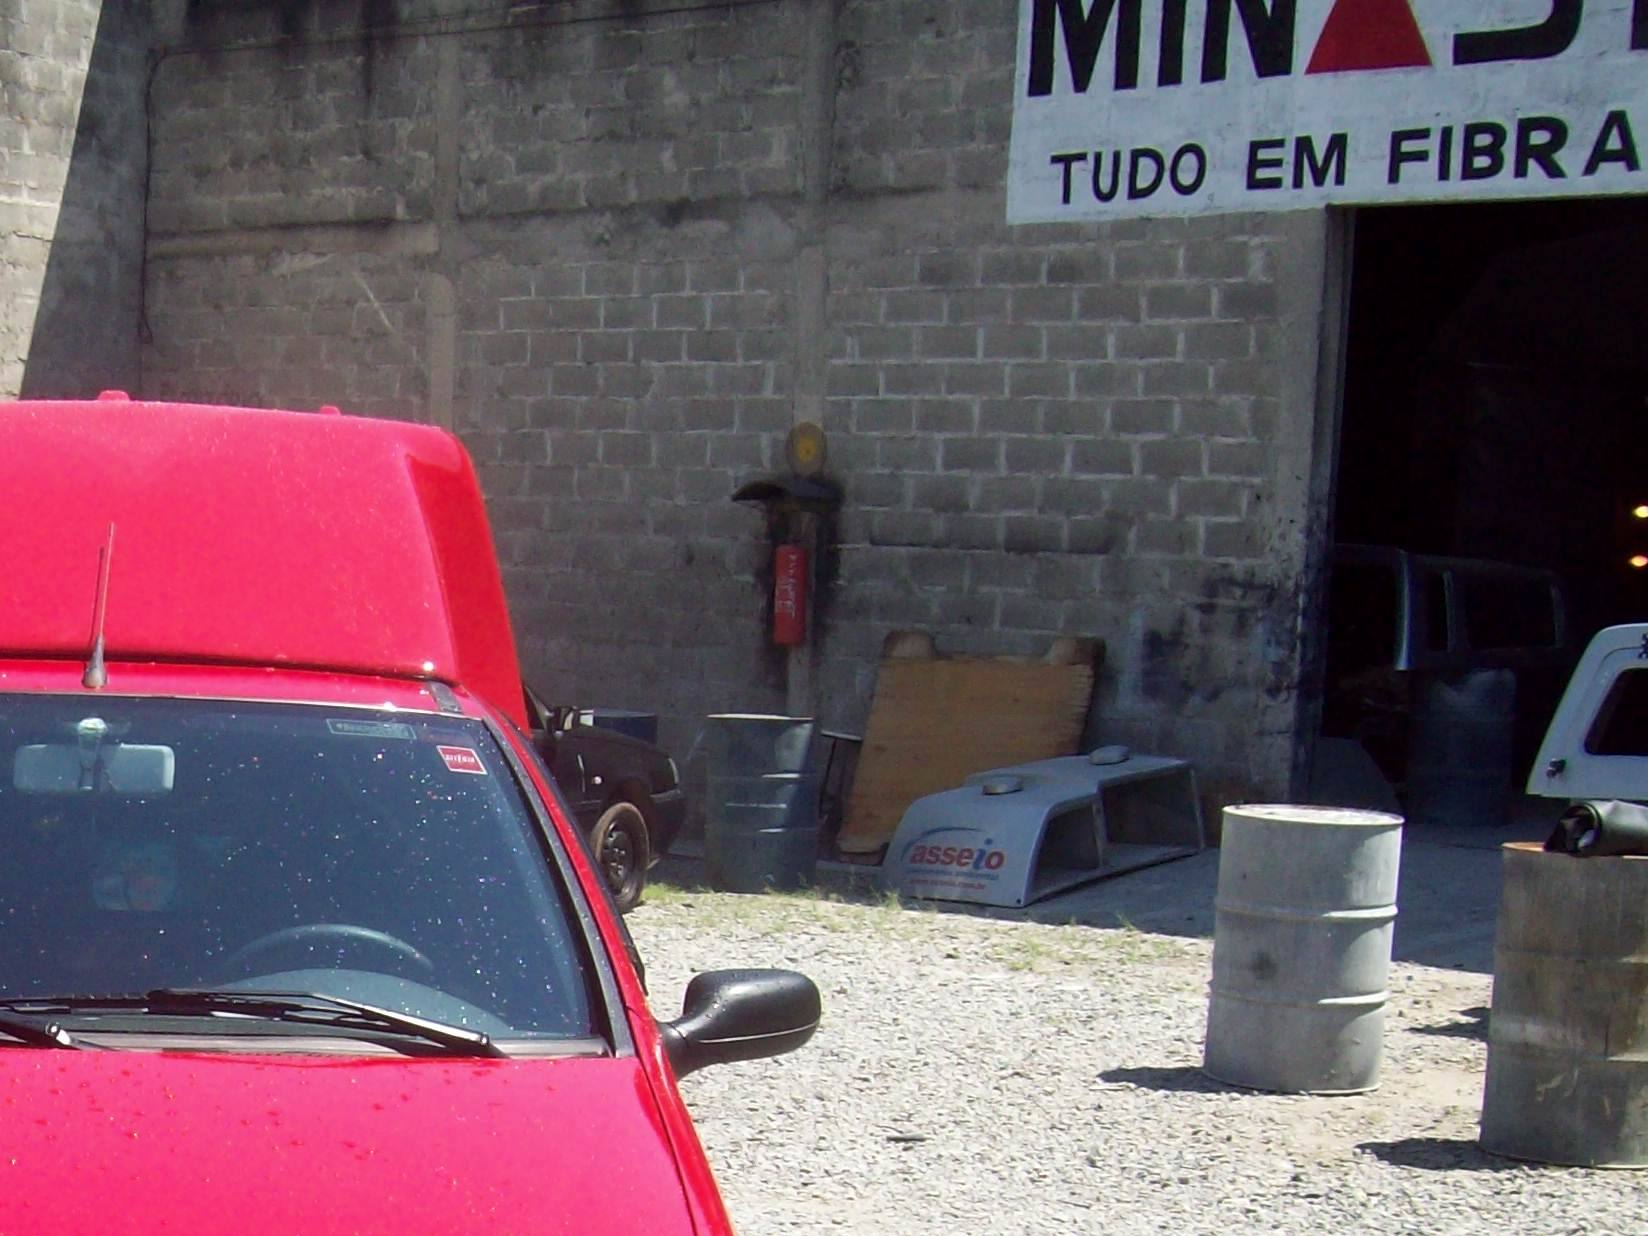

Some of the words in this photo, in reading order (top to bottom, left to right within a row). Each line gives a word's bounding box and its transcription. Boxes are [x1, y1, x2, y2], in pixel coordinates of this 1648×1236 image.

[1050, 143, 1207, 205] TUDO
[1246, 132, 1348, 190] EM
[1387, 109, 1641, 184] FIBRA
[909, 838, 1005, 870] asseio
